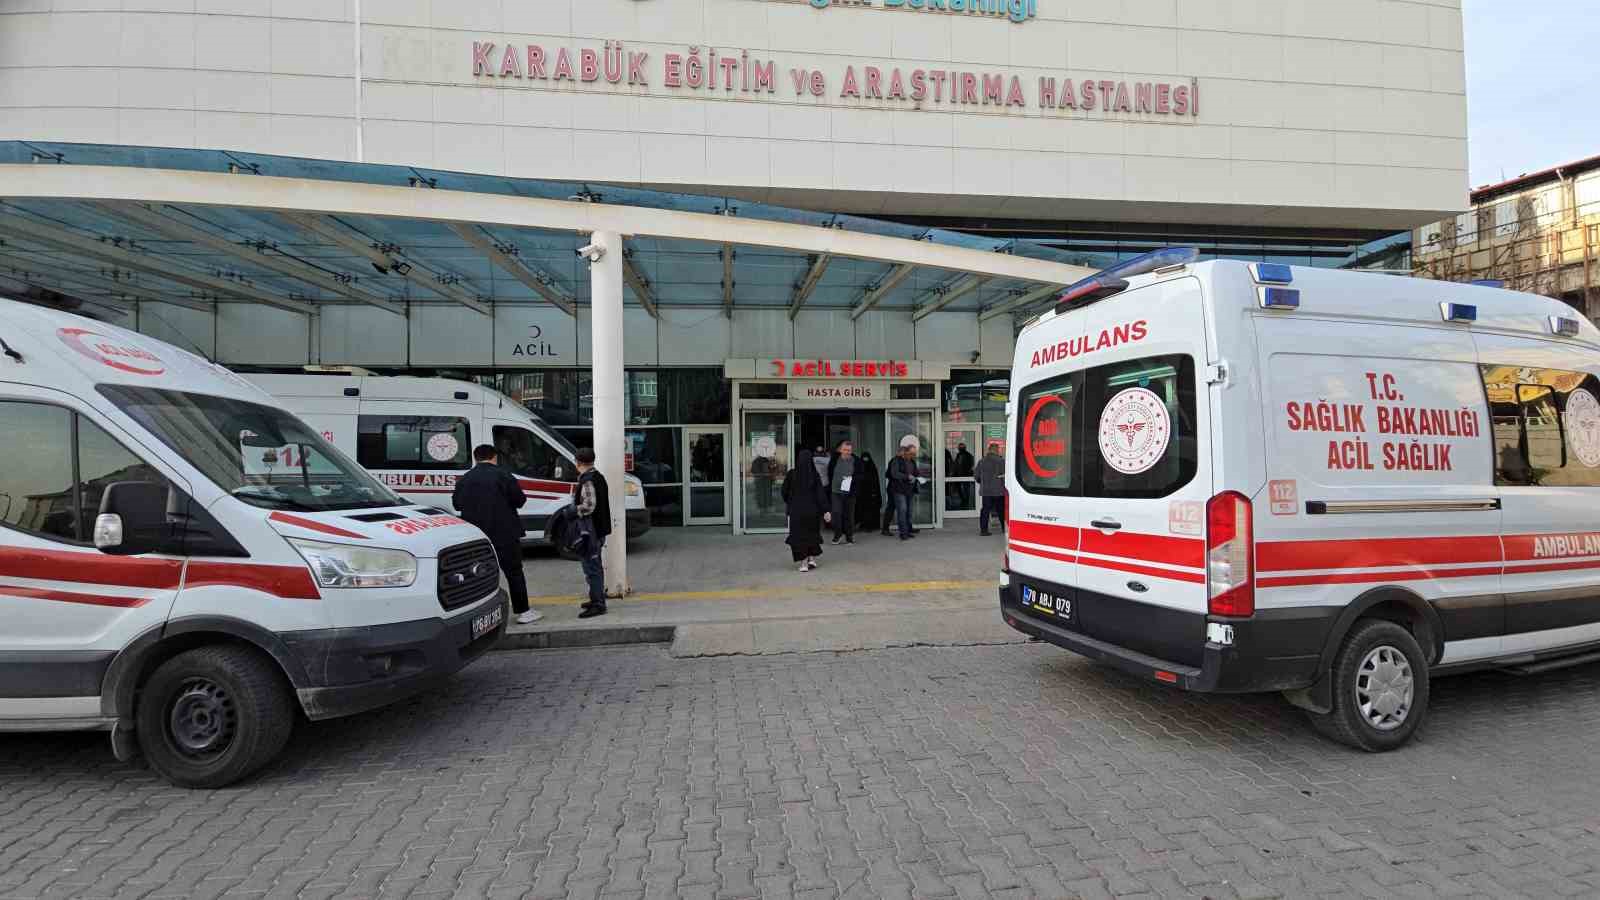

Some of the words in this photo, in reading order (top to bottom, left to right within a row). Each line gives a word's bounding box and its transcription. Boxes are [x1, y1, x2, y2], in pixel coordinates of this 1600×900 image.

[884, 0, 1037, 23] anığı
[472, 39, 648, 85] KARABÜK
[664, 46, 776, 93] EĞİTİM
[790, 67, 825, 96] ve
[840, 65, 1025, 110] ARAŞTIRMA
[1038, 76, 1199, 116] HASTANESİ
[512, 341, 558, 356] ACİL
[1031, 320, 1148, 368] AMBULANS
[792, 359, 835, 376] ACİL
[840, 359, 908, 376] SERVİS
[807, 388, 841, 397] HASTA
[1366, 372, 1403, 400] T.C.
[1287, 399, 1365, 432] SAĞLIK
[1377, 403, 1479, 437] BAKANLIĞI
[1328, 436, 1374, 470] ACİL
[1383, 438, 1452, 471] SAĞLIK
[372, 473, 457, 488] MBULANS
[1056, 597, 1071, 614] 079
